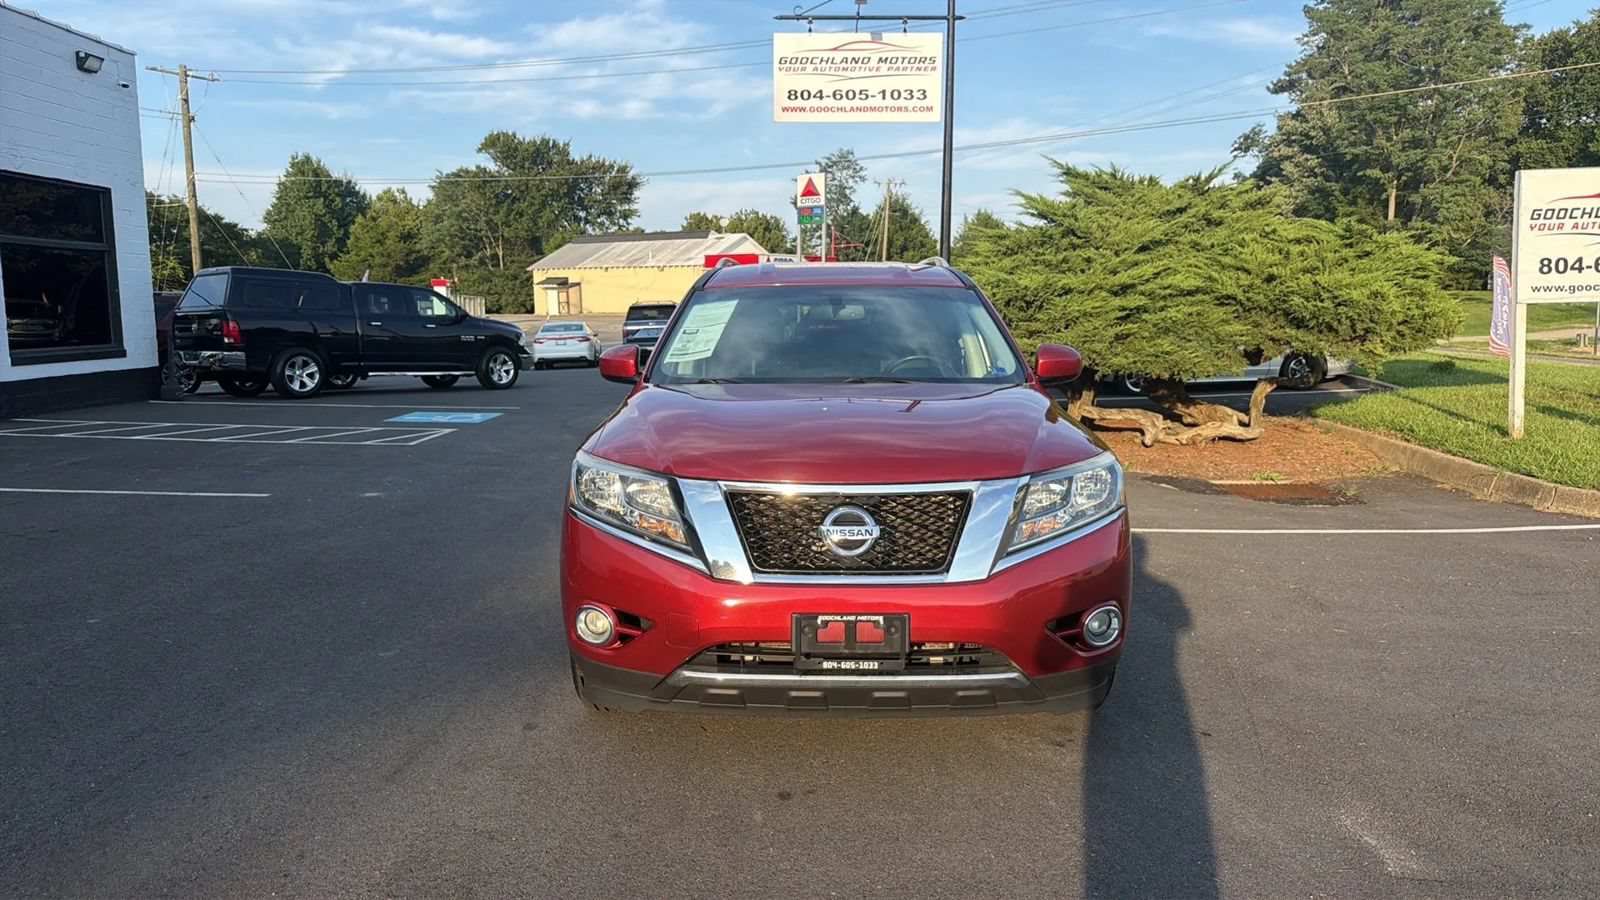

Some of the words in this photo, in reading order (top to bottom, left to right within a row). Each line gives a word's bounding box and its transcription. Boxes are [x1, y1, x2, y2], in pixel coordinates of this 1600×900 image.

[778, 56, 871, 65] GOOCHLAND
[877, 56, 937, 65] MOTORS
[787, 89, 928, 101] 804-605-1033
[1529, 222, 1565, 231] YOUR
[1571, 221, 1600, 230] AUT
[826, 529, 874, 537] NISSAN
[822, 661, 879, 669] 804-605-1033
